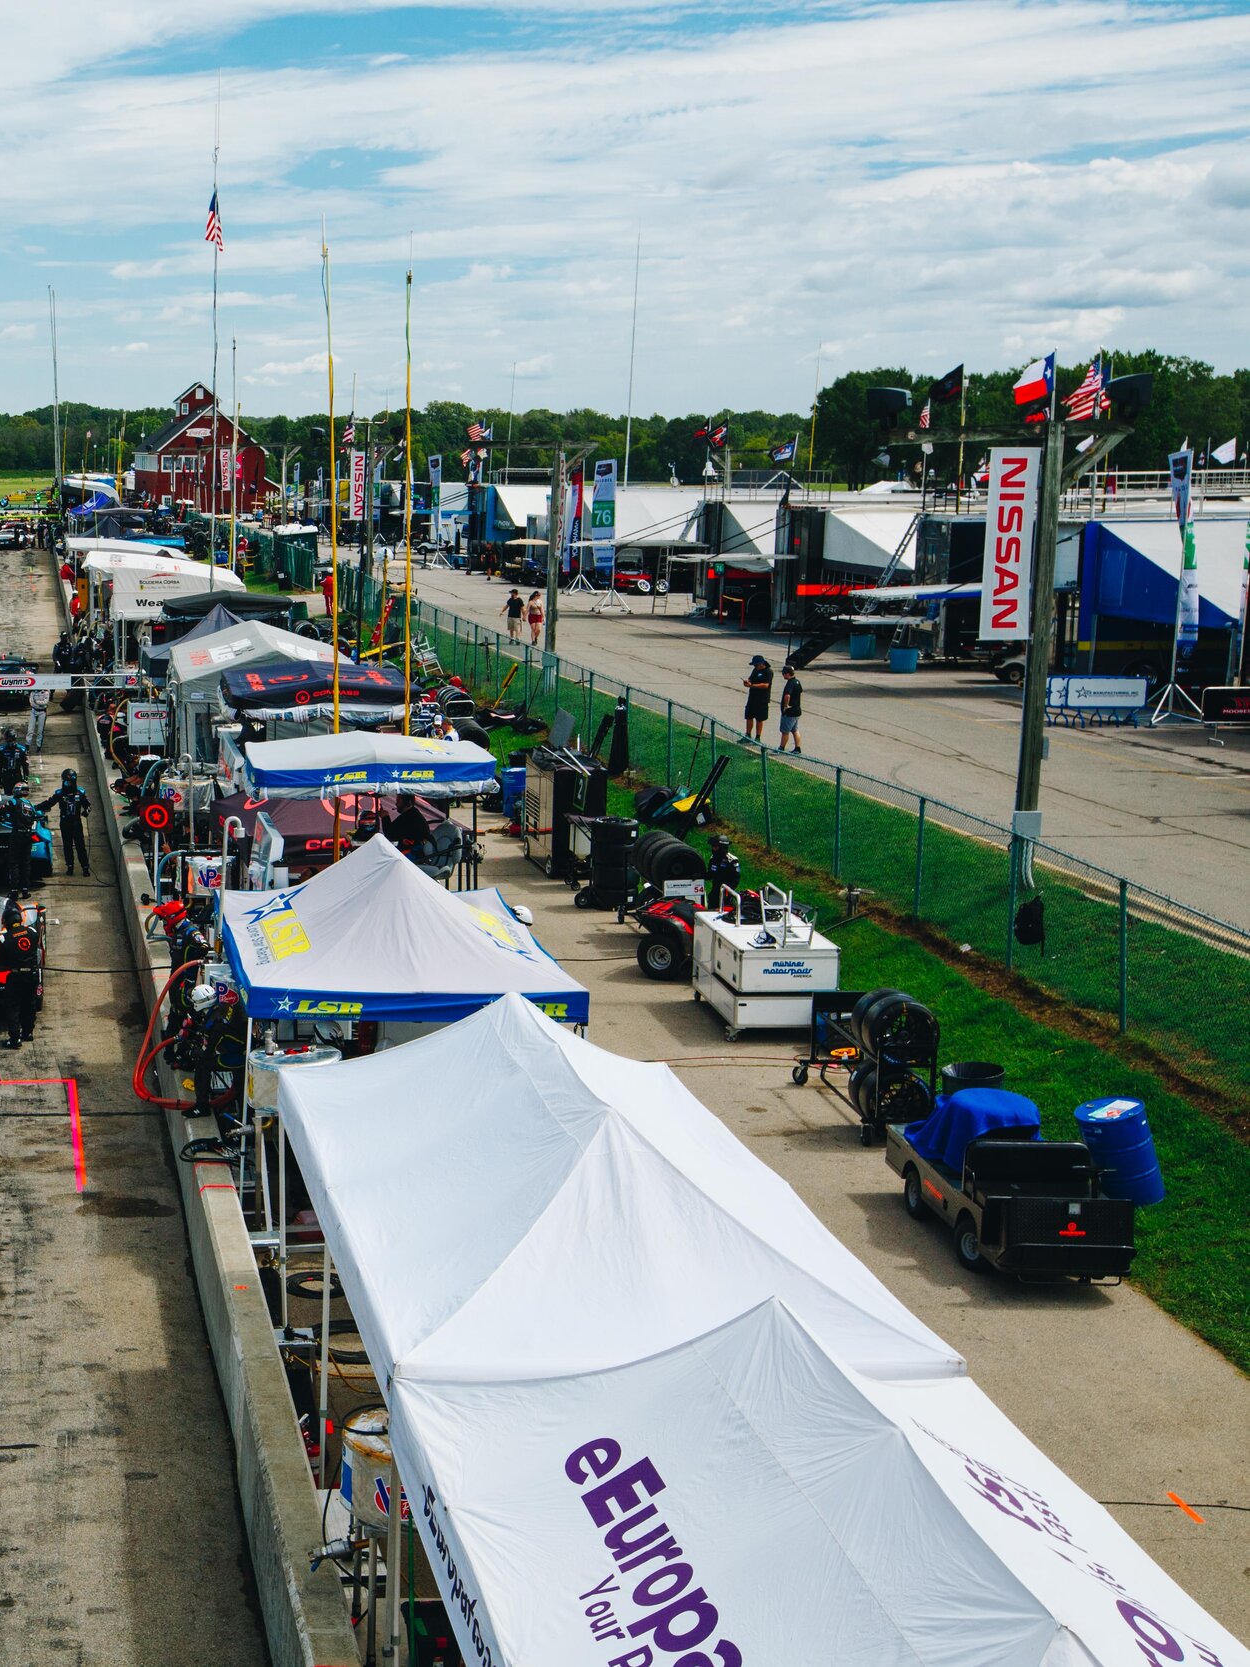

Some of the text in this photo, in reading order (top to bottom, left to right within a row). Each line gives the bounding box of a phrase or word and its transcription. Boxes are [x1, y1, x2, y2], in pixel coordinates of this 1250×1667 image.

[354, 455, 364, 516] NISSAN
[594, 509, 611, 525] 76
[571, 519, 580, 558] YOOHAMA
[992, 458, 1028, 629] NISSAN
[136, 599, 164, 607] Wea
[313, 689, 360, 697] COMASS
[333, 771, 367, 781] LSR
[401, 770, 435, 779] LSR
[198, 868, 218, 888] VP
[261, 909, 312, 962] LSR
[292, 1000, 363, 1014] LSR
[579, 1573, 626, 1642] Your
